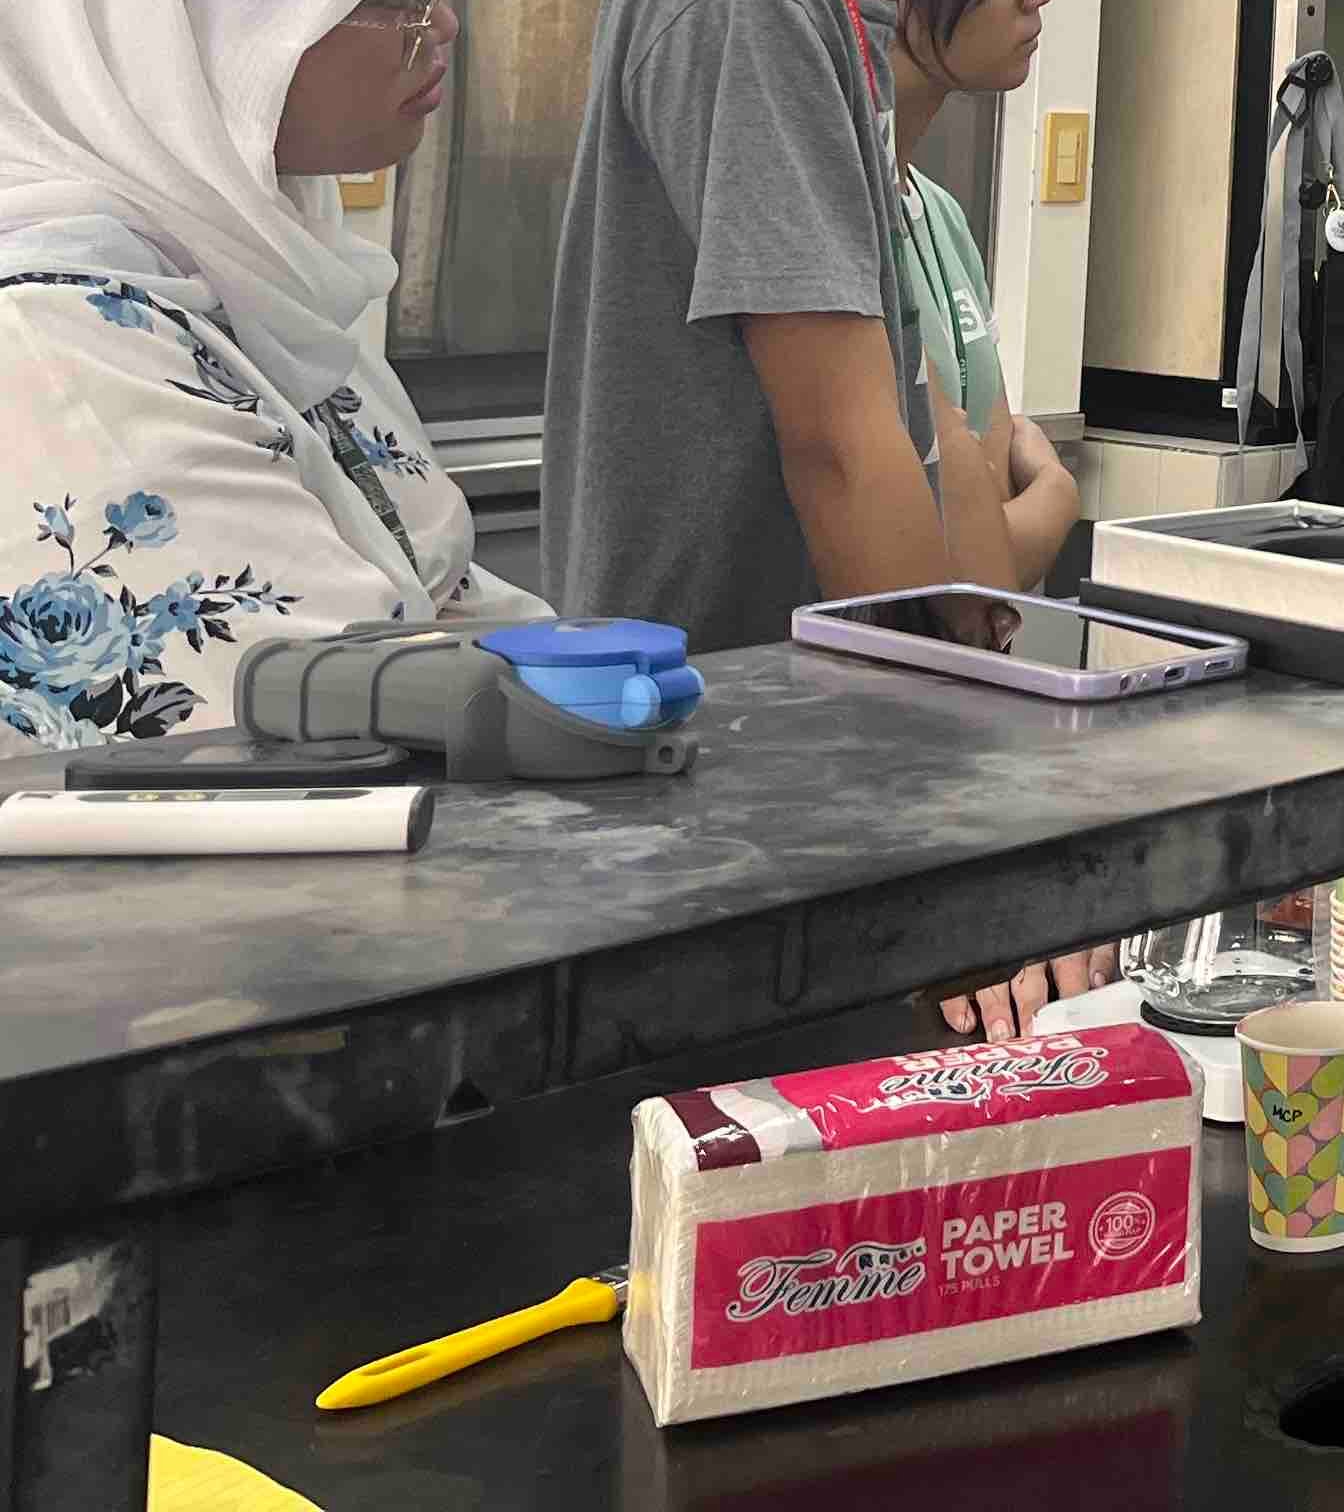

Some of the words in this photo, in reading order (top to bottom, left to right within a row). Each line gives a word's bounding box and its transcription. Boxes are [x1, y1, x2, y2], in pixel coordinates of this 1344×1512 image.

[942, 1201, 1068, 1249] PAPER
[727, 1238, 928, 1323] Femme
[940, 1231, 1074, 1281] TOWEL
